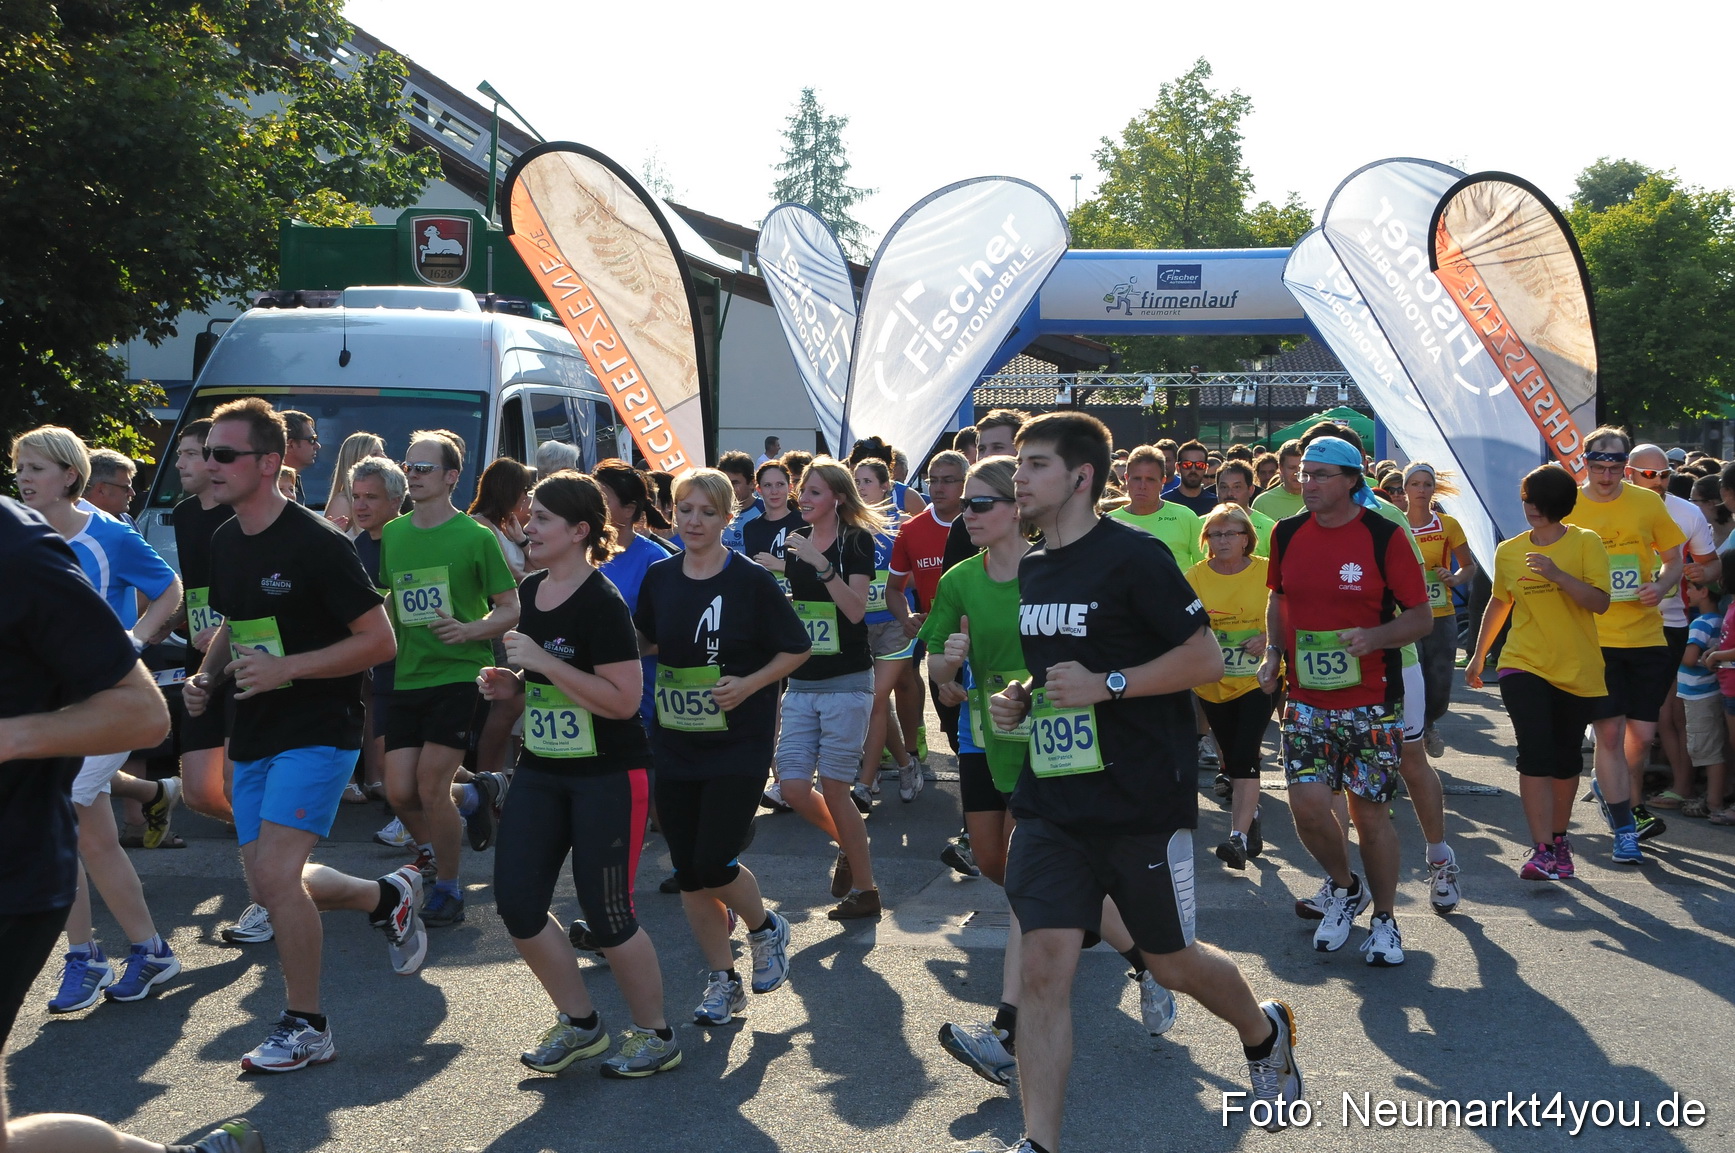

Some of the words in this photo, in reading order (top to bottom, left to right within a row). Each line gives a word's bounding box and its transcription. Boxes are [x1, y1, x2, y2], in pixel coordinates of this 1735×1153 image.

[430, 269, 454, 279] 1628
[1166, 273, 1199, 281] Fischer
[902, 213, 1022, 375] Fischer
[945, 243, 1036, 369] AUTOMOBILE
[1141, 290, 1239, 308] firmenlauf
[1420, 534, 1445, 543] BÖGL
[1612, 570, 1639, 590] 82
[403, 587, 443, 613] 603
[191, 607, 222, 632] 315
[1303, 651, 1348, 676] 153
[657, 687, 720, 716] 1053
[530, 709, 580, 739] 313
[1030, 713, 1094, 755] 1395
